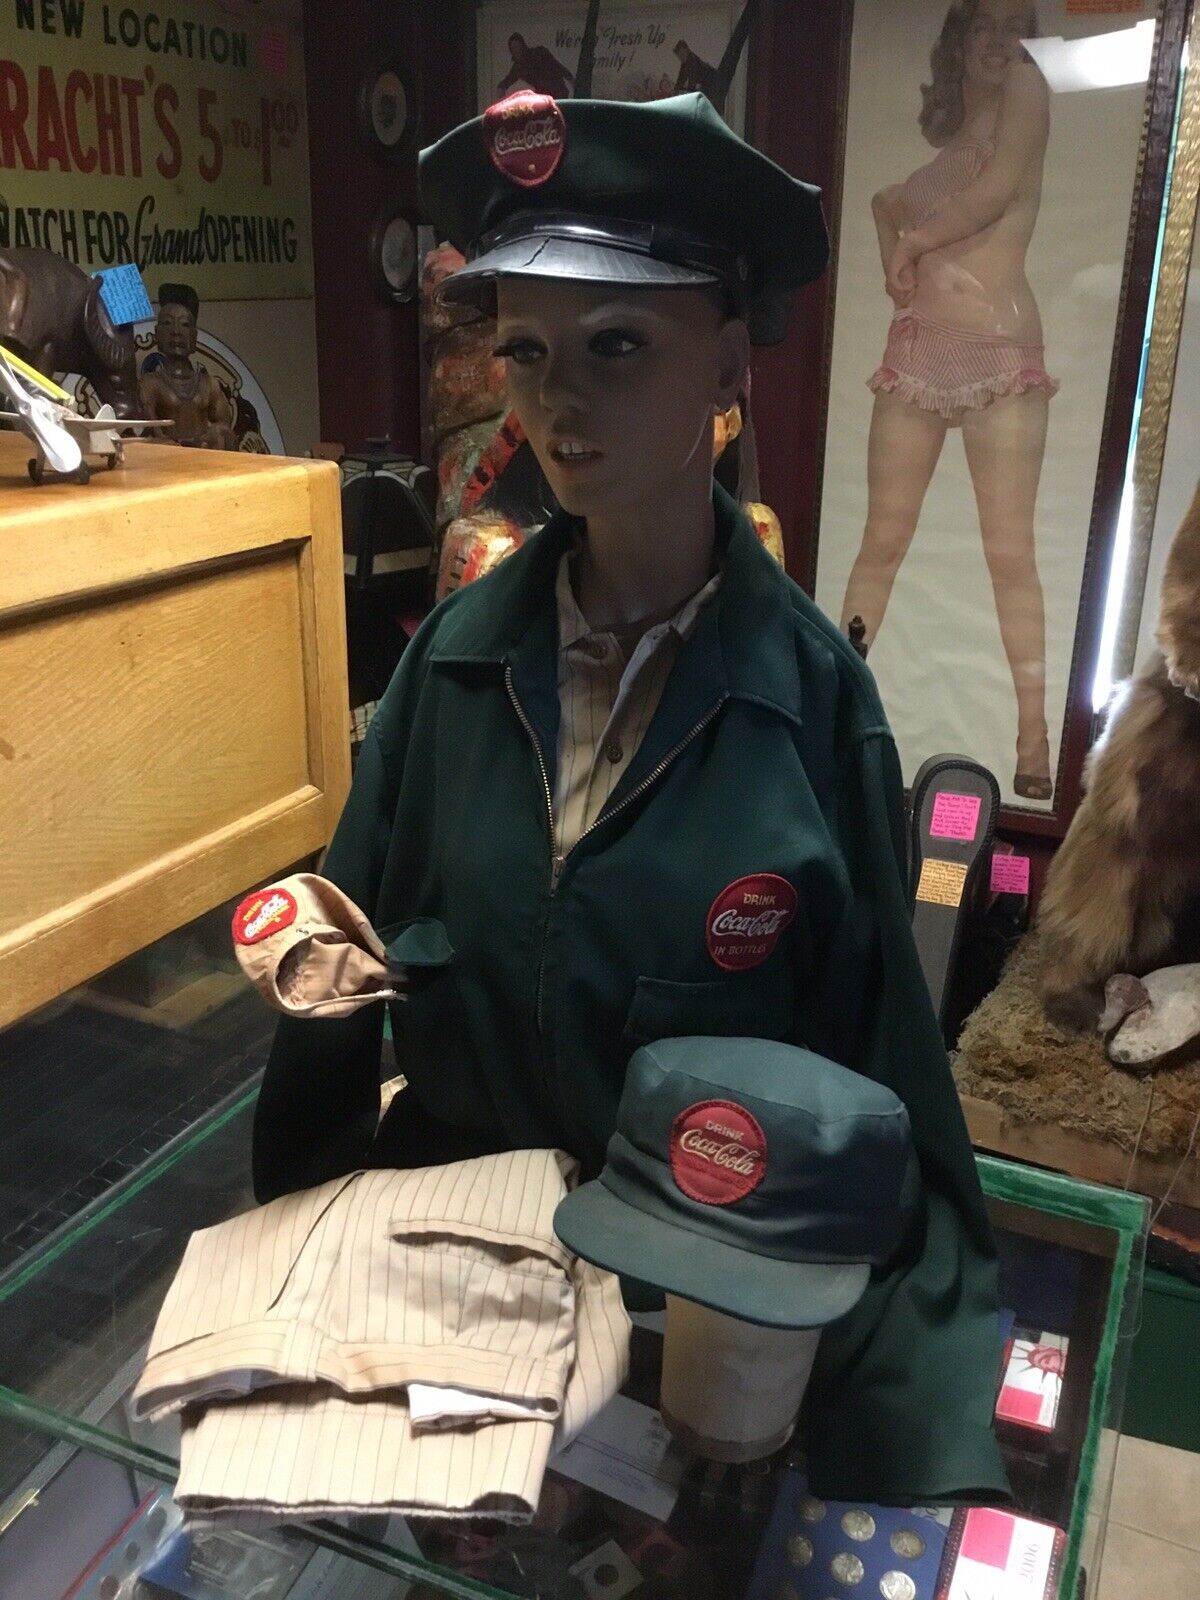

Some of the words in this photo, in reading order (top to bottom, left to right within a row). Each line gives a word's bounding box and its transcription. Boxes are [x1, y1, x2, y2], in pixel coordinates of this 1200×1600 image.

[15, 0, 84, 39] NEW
[102, 5, 249, 68] LOCATION
[83, 210, 132, 264] FOR
[133, 195, 206, 275] Grand
[201, 213, 298, 264] OPENING
[743, 892, 777, 907] DRINK
[714, 945, 727, 956] IN
[705, 1120, 745, 1141] DRINK
